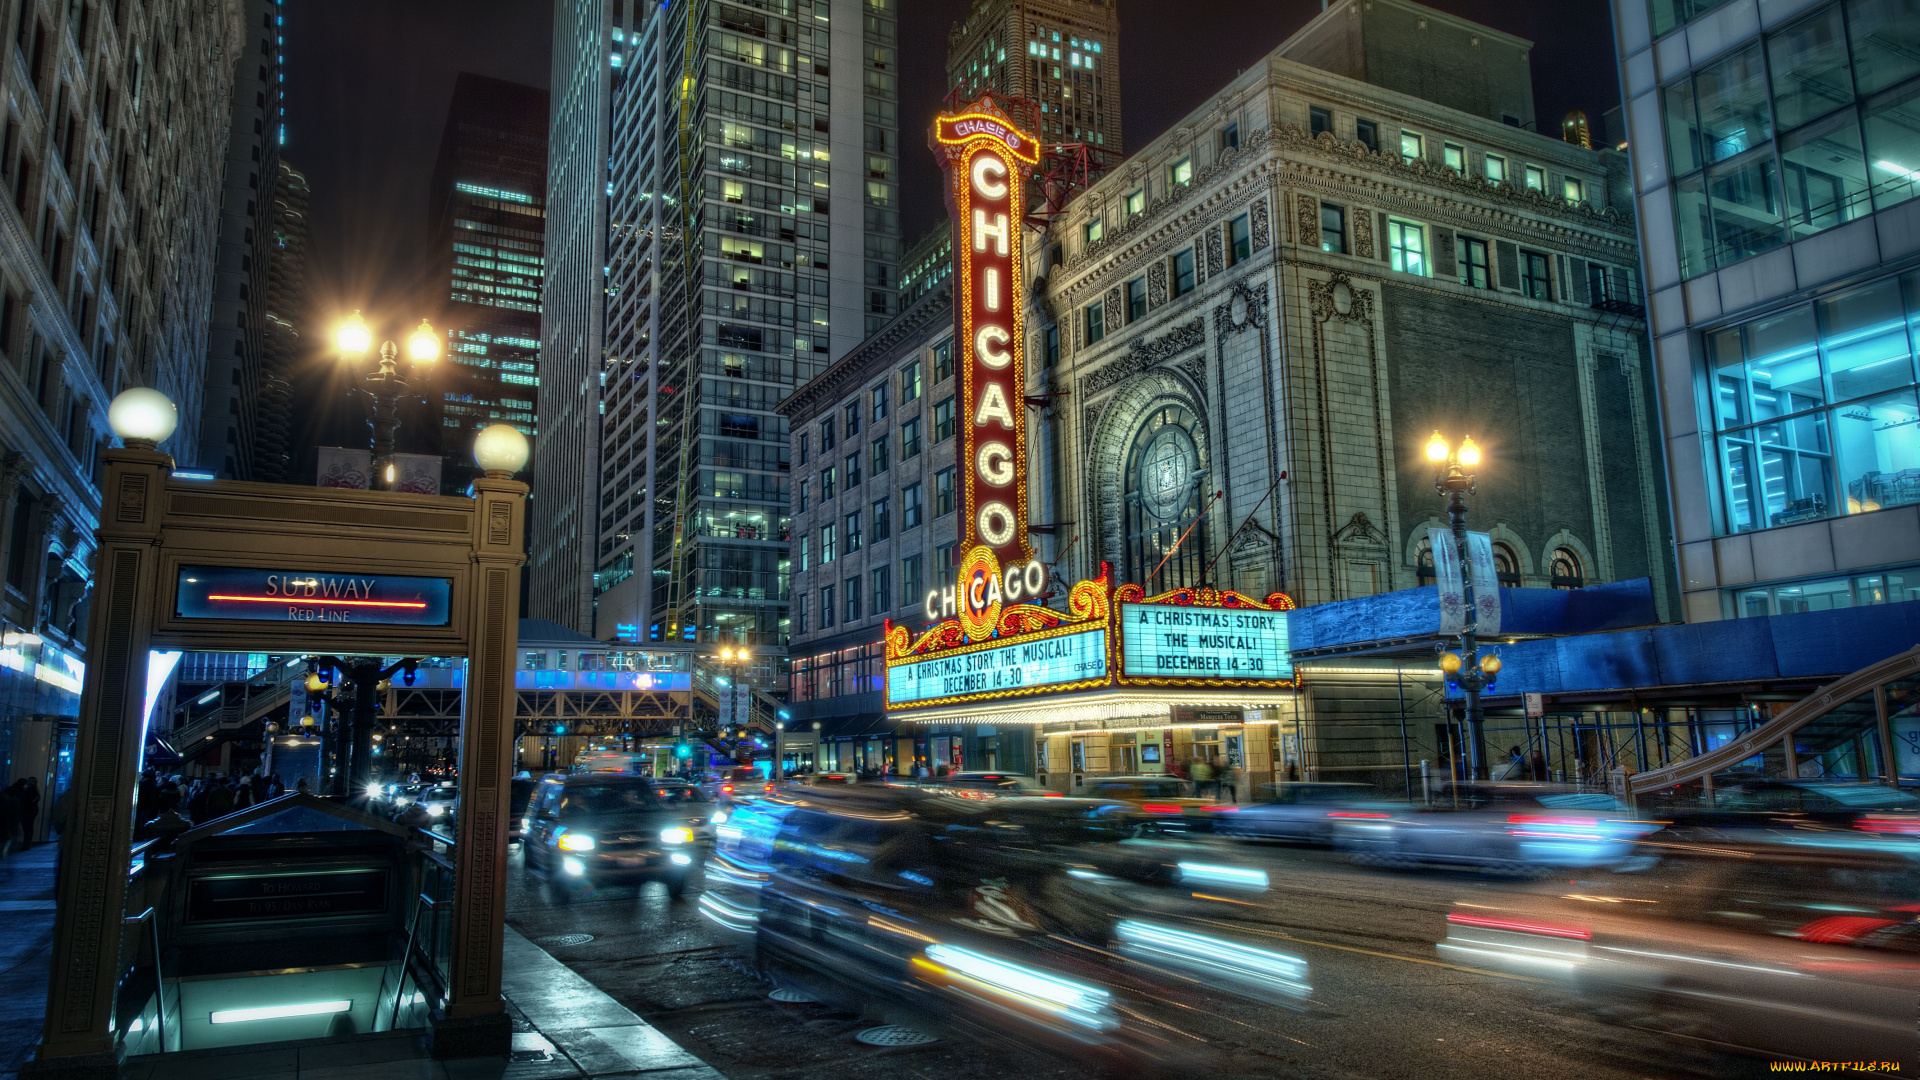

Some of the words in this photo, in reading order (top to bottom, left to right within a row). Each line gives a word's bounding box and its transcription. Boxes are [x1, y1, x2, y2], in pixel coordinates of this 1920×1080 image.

[955, 120, 1007, 140] CHASE
[970, 154, 1018, 545] CHICAGO
[266, 574, 375, 600] SUBWAY
[926, 560, 1044, 621] CHICAGO
[288, 605, 315, 622] RED
[319, 607, 350, 622] LINE
[1139, 610, 1149, 625] A
[1155, 611, 1229, 628] CHRISTMAS
[1236, 614, 1275, 631] STORY,
[1164, 633, 1188, 648] THE
[1199, 634, 1257, 650] MUSICAL!
[907, 669, 913, 681] A
[916, 658, 962, 680] CHRISTMAS
[966, 651, 993, 672] STORY,
[999, 647, 1017, 666] THE
[1022, 637, 1073, 663] MUSICAL!
[1074, 661, 1097, 671] CHASE
[1156, 655, 1220, 670] DECEMBER
[943, 673, 987, 693] DECEMBER
[279, 882, 321, 893] HOWARD
